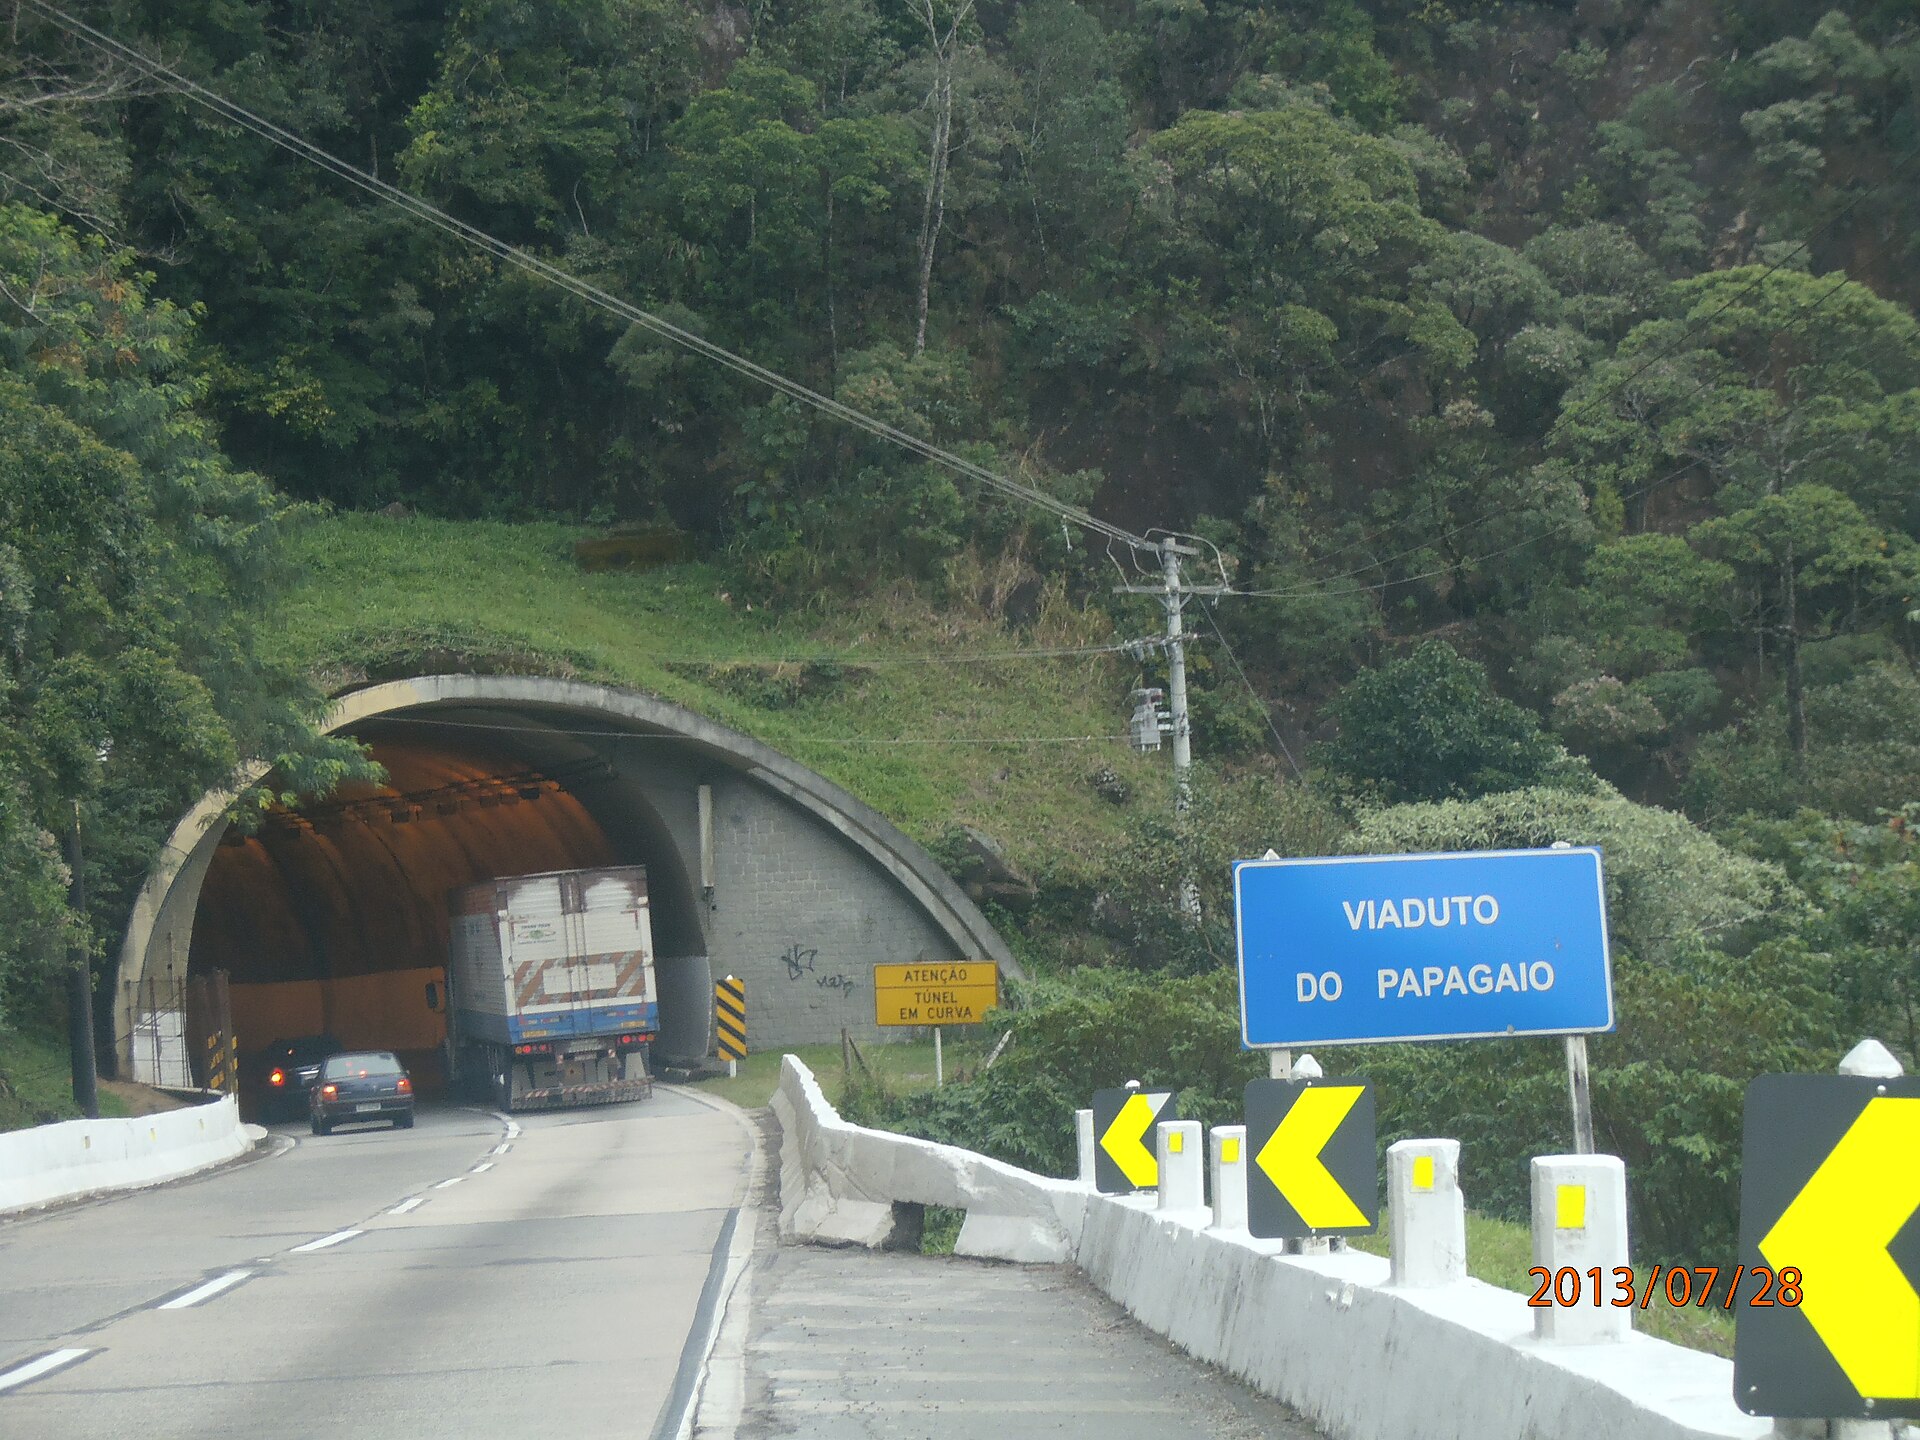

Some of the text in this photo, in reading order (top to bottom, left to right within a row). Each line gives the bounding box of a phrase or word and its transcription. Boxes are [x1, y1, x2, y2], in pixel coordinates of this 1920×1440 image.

[1342, 894, 1499, 930] VIADUTO
[904, 967, 967, 984] ATENÇÃO
[1296, 961, 1555, 1002] DO PAPAGAIO
[915, 988, 957, 1004] TÚNEL
[900, 1006, 972, 1020] EM CURVA
